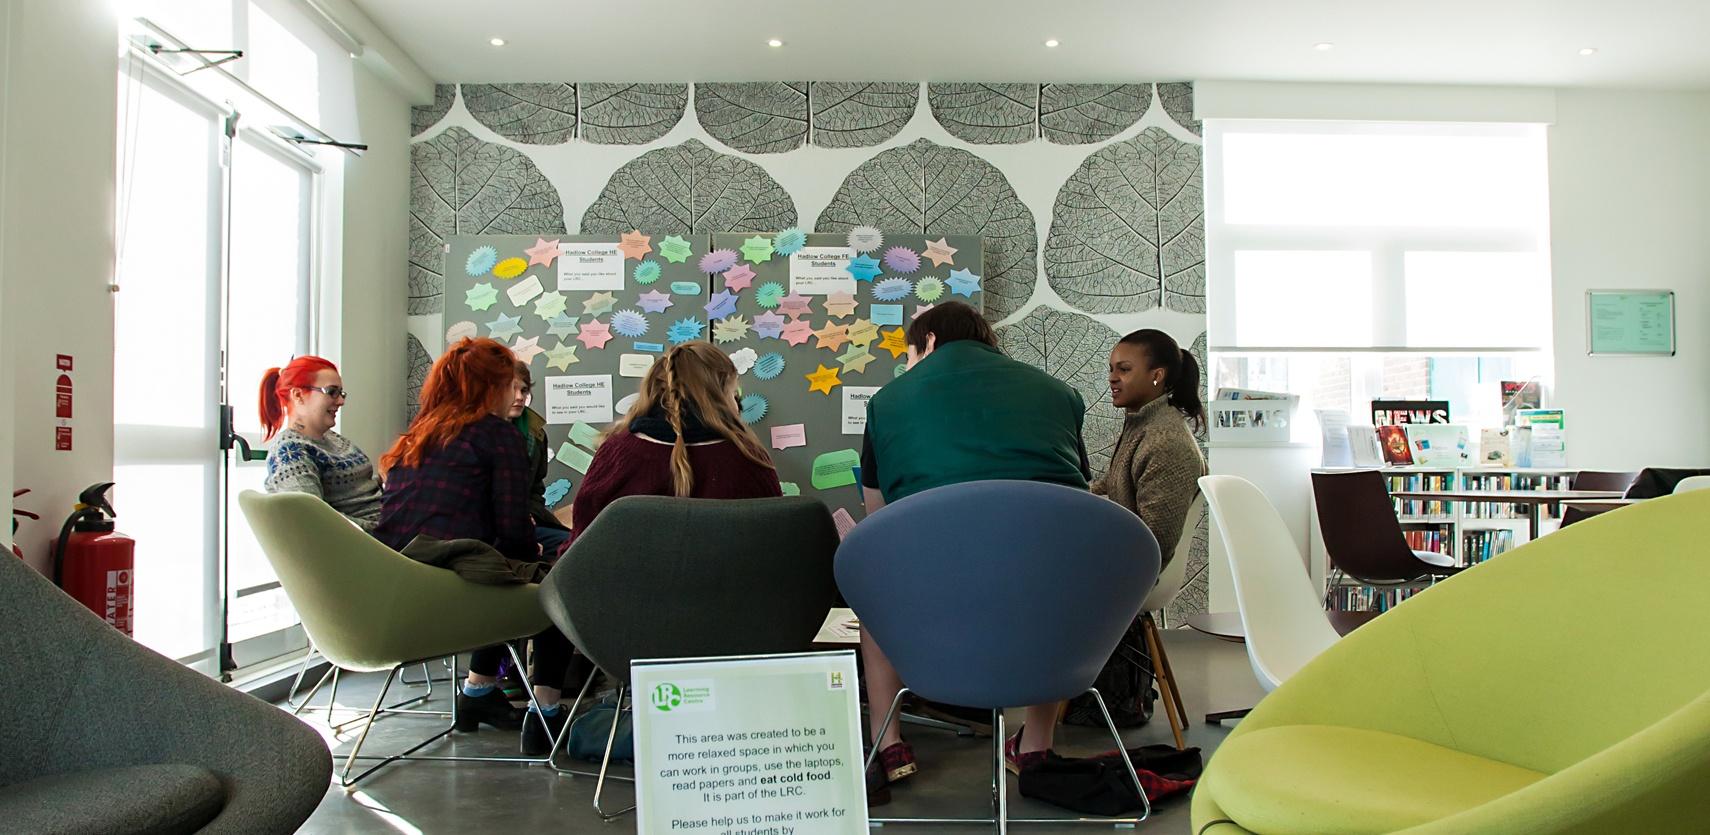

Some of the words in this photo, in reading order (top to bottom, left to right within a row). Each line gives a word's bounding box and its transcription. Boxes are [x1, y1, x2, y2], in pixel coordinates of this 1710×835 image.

[1214, 410, 1288, 428] NEWS
[1374, 409, 1448, 428] NEWS
[106, 586, 116, 626] ATER
[675, 734, 697, 744] This
[700, 734, 724, 743] area
[727, 732, 748, 741] was
[750, 728, 788, 740] created
[791, 728, 801, 737] to
[804, 727, 816, 736] be
[668, 752, 695, 760] more
[698, 748, 736, 759] relaxed
[739, 747, 770, 758] space
[773, 744, 782, 754] in
[784, 742, 814, 753] which
[817, 743, 835, 754] you
[660, 769, 679, 777] can
[682, 765, 706, 776] work
[710, 765, 719, 774] in
[722, 764, 761, 776] groups,
[764, 762, 782, 770] use
[785, 760, 801, 769] the
[804, 758, 844, 768] laptops,
[672, 780, 696, 791] read
[699, 780, 734, 791] papers
[738, 776, 757, 786] and
[761, 775, 777, 784] eat
[780, 772, 803, 783] cold
[703, 793, 709, 802] It
[713, 793, 721, 801] is
[725, 791, 744, 803] part
[748, 789, 757, 799] of
[761, 788, 777, 798] the
[780, 786, 806, 797] LRC.
[672, 820, 708, 829] Please
[711, 816, 734, 827] help
[736, 816, 749, 825] us
[752, 814, 762, 823] to
[765, 812, 793, 822] make
[796, 811, 801, 820] it
[805, 808, 829, 819] work
[831, 807, 845, 817] for
[782, 826, 794, 835] by
